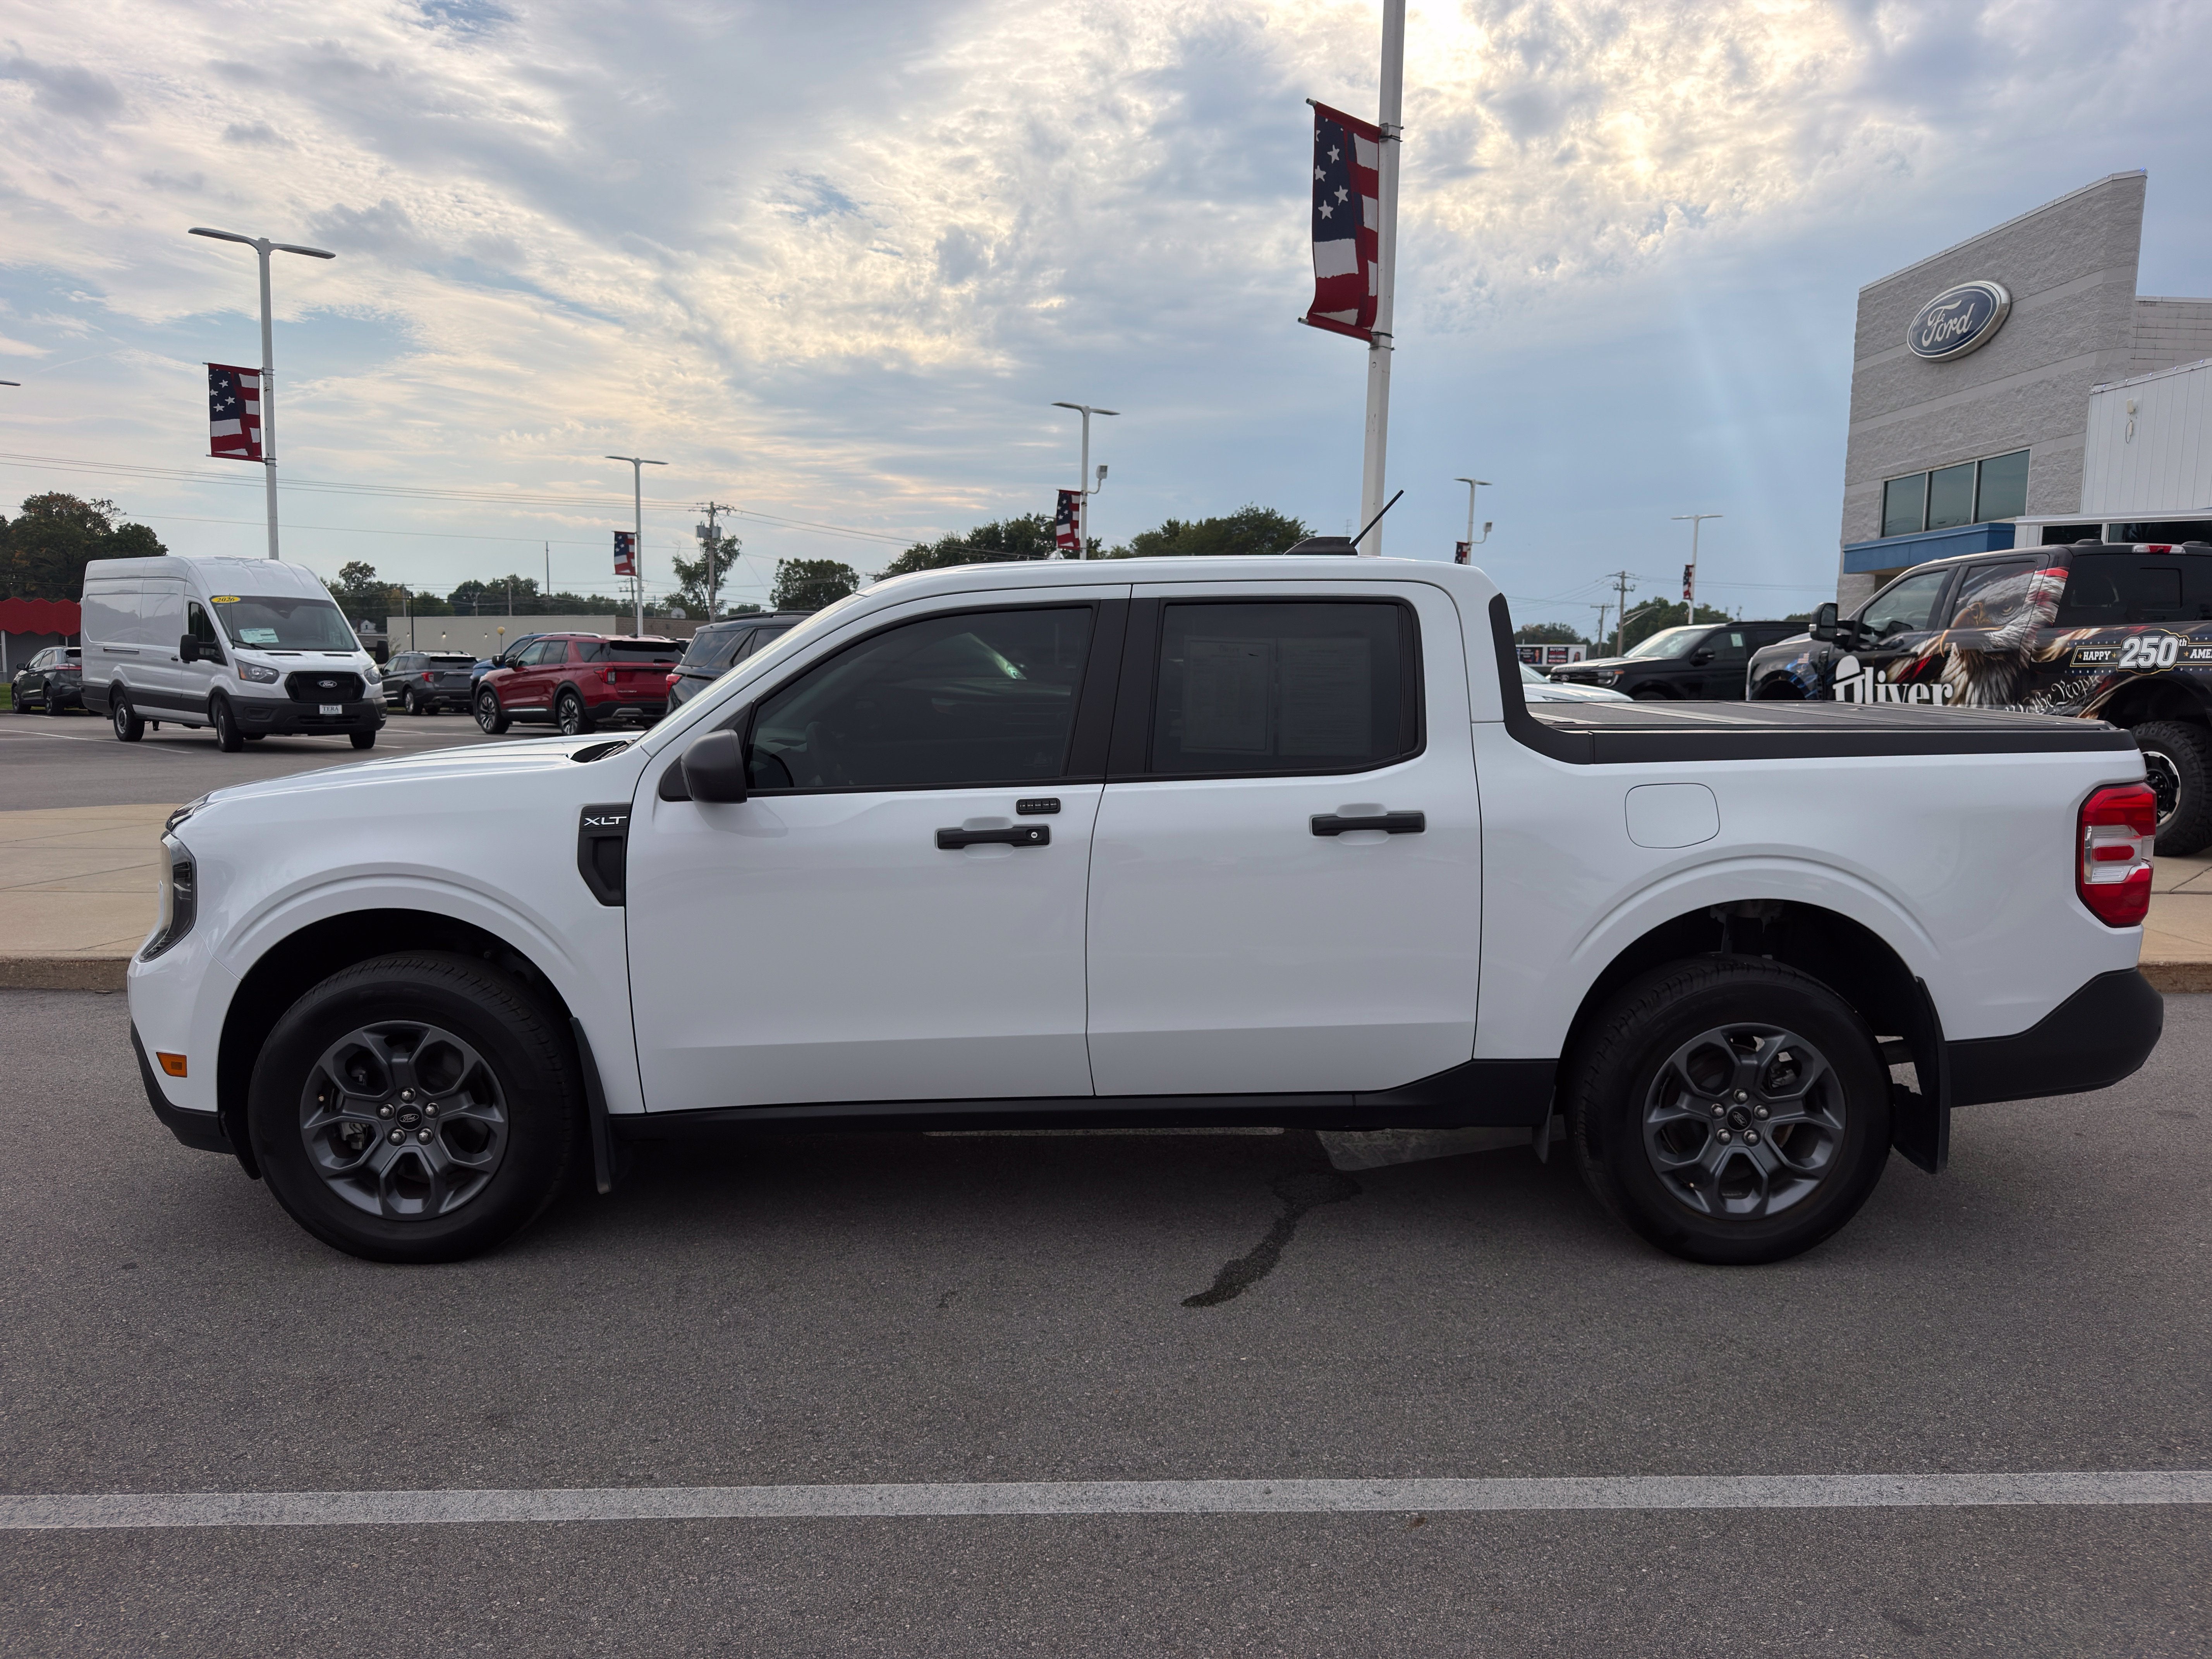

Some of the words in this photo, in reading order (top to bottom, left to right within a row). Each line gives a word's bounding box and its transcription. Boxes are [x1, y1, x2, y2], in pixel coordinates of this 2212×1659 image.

[1922, 300, 1975, 347] Ford
[2083, 651, 2111, 661] HAPPY
[2190, 649, 2212, 659] AME
[1832, 654, 1954, 706] Oliver
[584, 816, 627, 826] XLT
